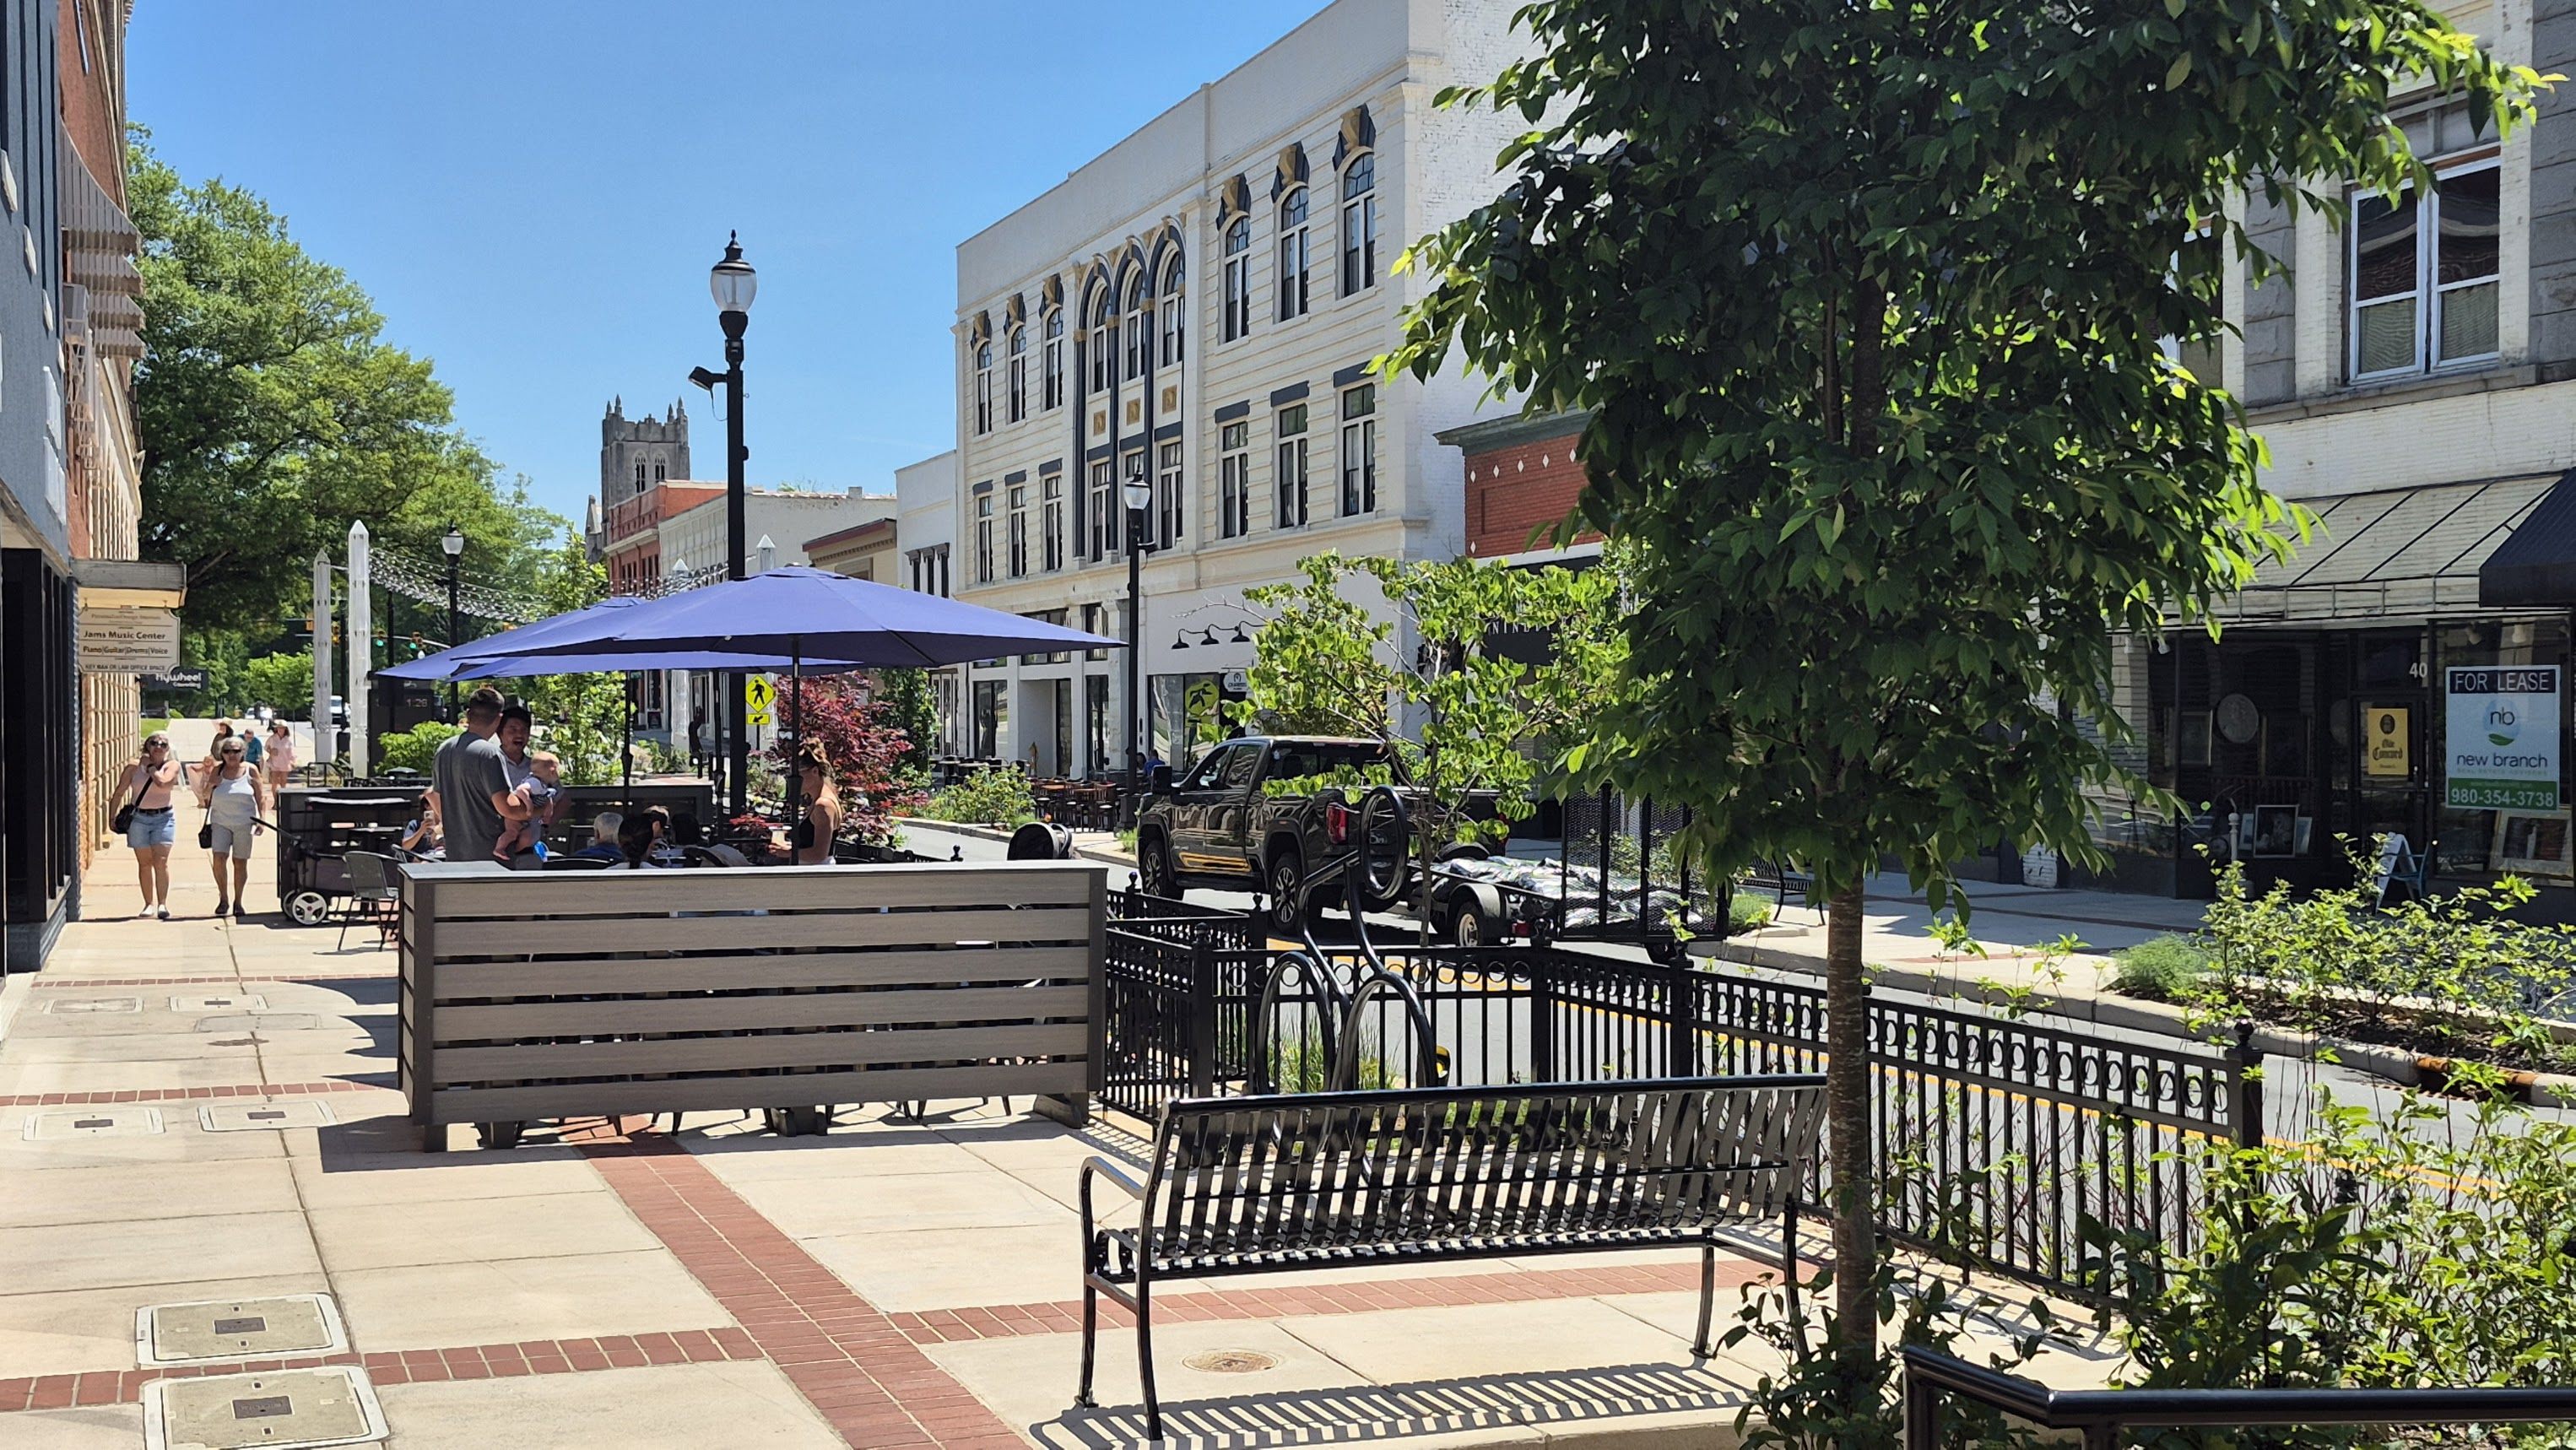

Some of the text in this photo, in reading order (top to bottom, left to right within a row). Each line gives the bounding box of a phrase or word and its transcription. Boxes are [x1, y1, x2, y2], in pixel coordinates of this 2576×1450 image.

[84, 630, 165, 641] Jams Music Center
[2409, 663, 2428, 678] 40
[2455, 672, 2550, 691] FOR LEASE
[2490, 706, 2515, 726] nb
[2457, 753, 2548, 768] new branch
[2451, 787, 2554, 807] 980-354-3738
